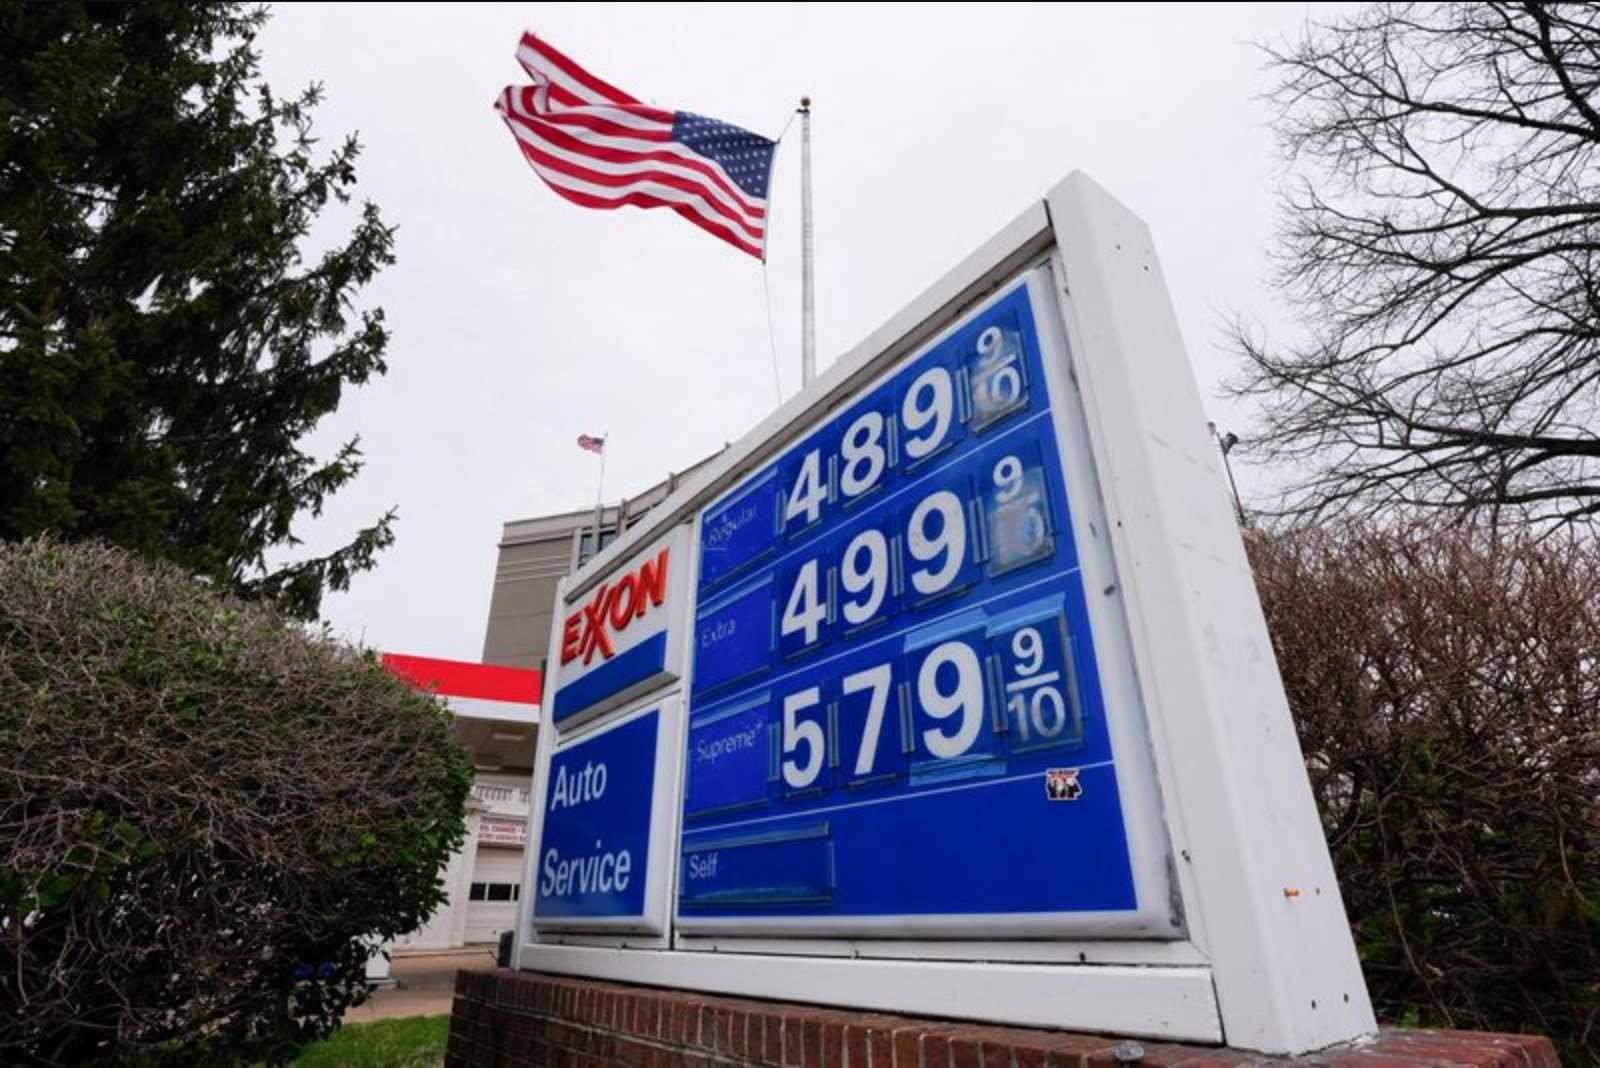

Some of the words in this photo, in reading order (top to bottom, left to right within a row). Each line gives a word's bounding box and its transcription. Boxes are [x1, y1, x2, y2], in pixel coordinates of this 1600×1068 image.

[993, 455, 1023, 503] 9
[560, 547, 671, 667] EXXON
[701, 617, 737, 648] Extra
[1012, 627, 1044, 676] 9
[1007, 685, 1066, 743] 10
[551, 761, 607, 810] Auto
[541, 838, 632, 897] Service
[688, 853, 719, 880] Self
